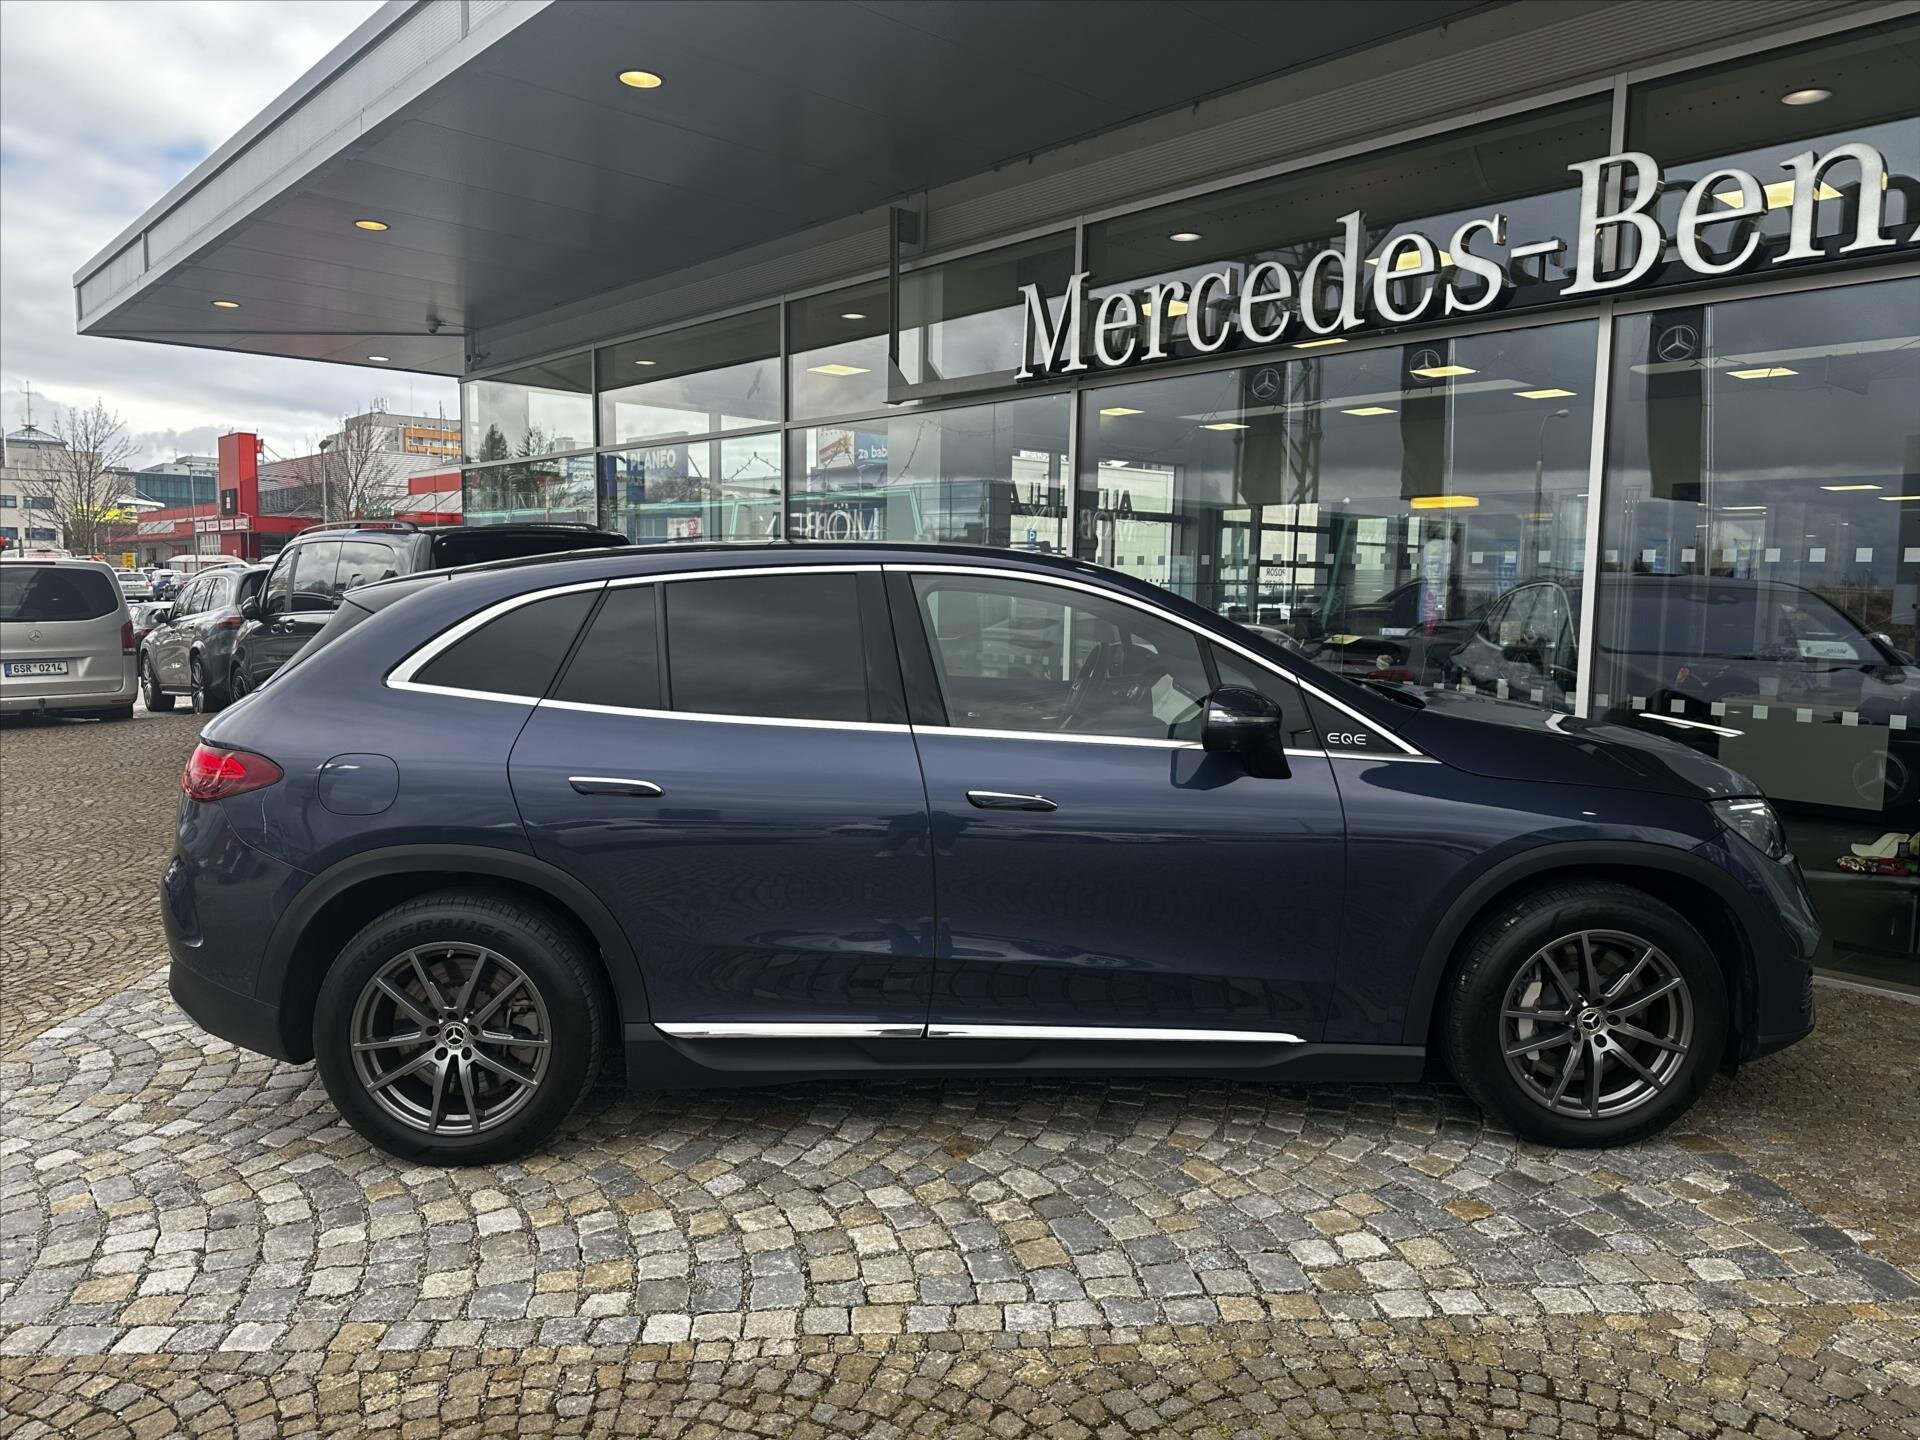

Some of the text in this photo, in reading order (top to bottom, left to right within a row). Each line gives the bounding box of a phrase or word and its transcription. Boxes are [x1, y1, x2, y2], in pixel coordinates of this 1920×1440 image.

[1014, 142, 1920, 380] Mercedes-Ben
[858, 448, 868, 459] za
[13, 664, 32, 673] 6SR
[38, 663, 63, 672] 0214
[1327, 732, 1367, 745] EQE
